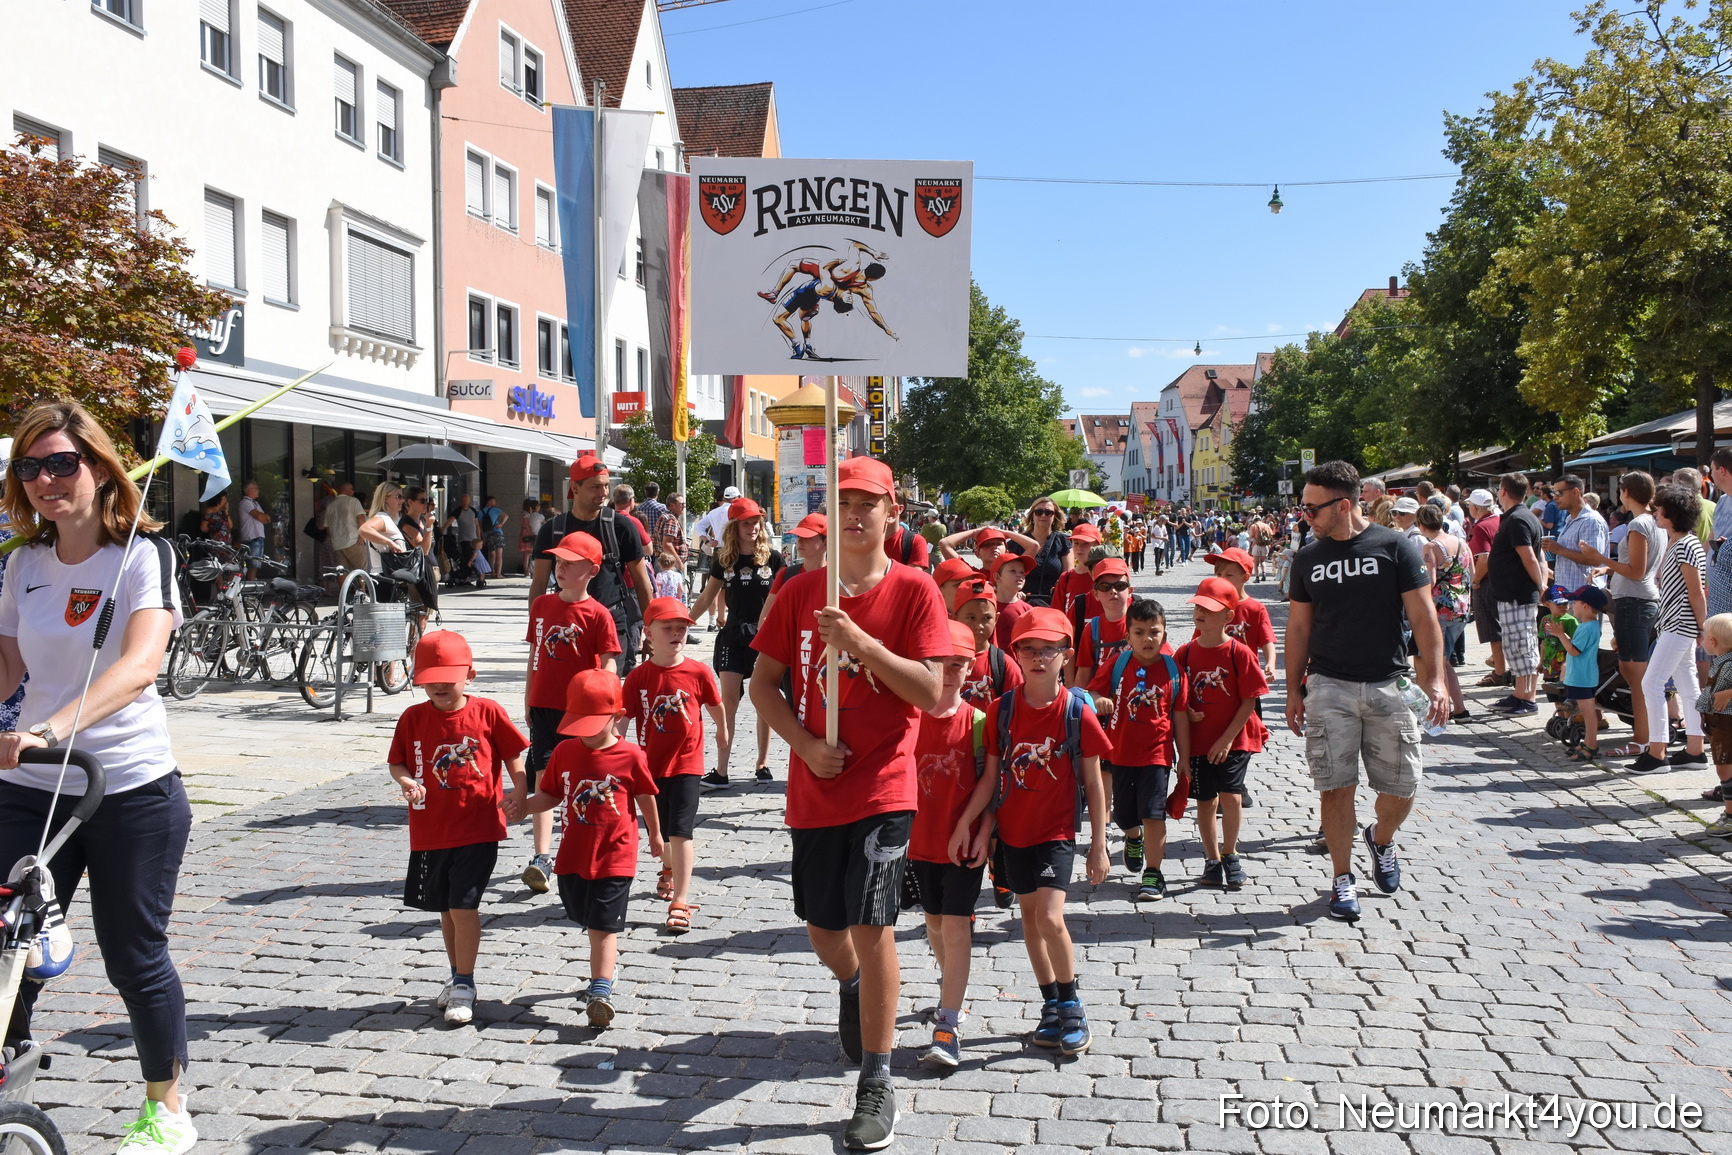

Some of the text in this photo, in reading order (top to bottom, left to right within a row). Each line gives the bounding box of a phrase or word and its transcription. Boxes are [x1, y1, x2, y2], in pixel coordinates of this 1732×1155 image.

[712, 194, 735, 213] ASV
[752, 176, 909, 237] RINGEN
[927, 196, 951, 216] ASV
[795, 215, 861, 224] ASV NEUMARKT
[450, 383, 491, 396] sutor.
[512, 384, 556, 419] sutor.
[617, 402, 639, 410] WITT
[869, 376, 884, 453] HOTEL
[1310, 557, 1379, 584] aqua
[72, 601, 90, 614] ASV
[413, 740, 426, 811] RNGEN
